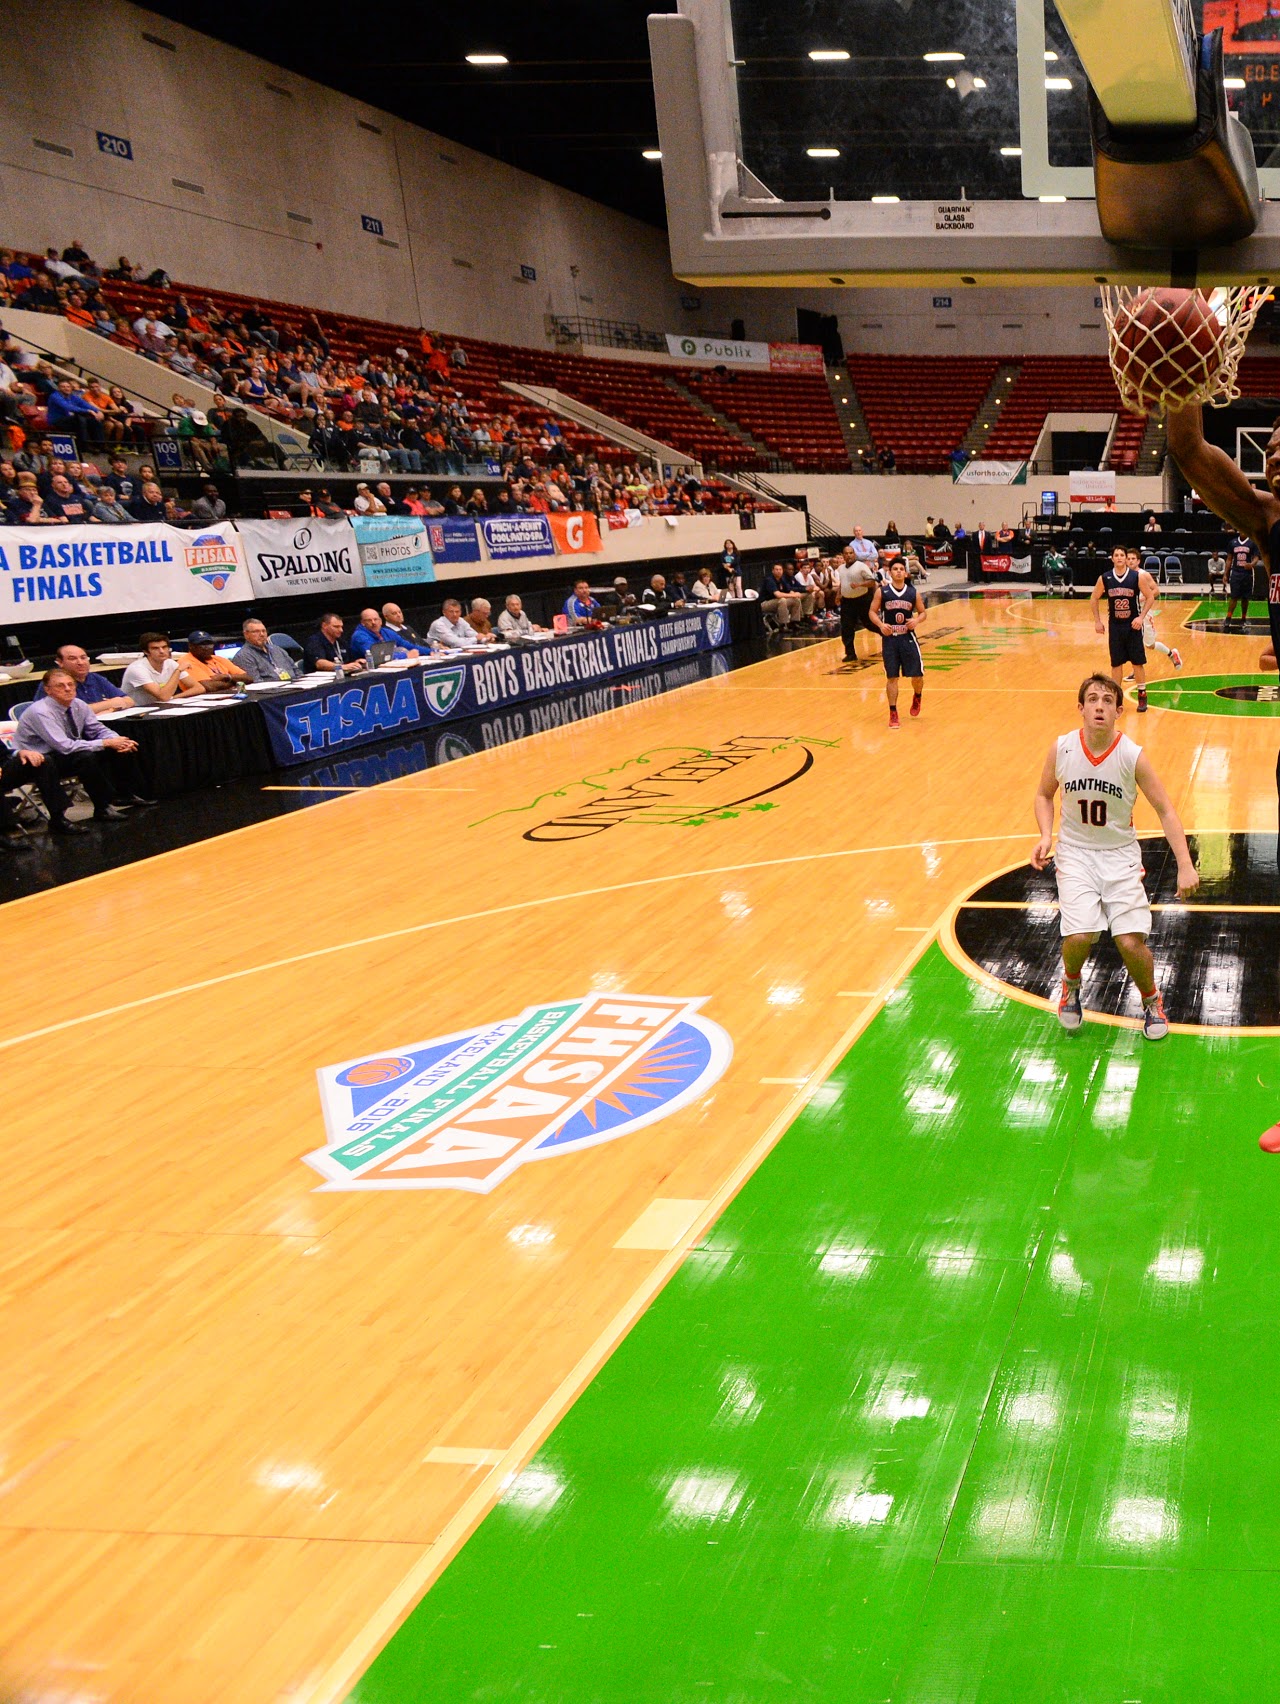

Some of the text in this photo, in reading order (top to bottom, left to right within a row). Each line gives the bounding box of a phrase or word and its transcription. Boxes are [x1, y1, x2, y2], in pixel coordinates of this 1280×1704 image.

[102, 135, 128, 156] 210
[938, 206, 971, 214] GUARDIAN
[944, 214, 965, 222] GLASS
[366, 219, 380, 233] 211
[936, 222, 975, 230] BACKBOARD
[704, 344, 752, 358] Publix
[53, 443, 73, 455] 108
[154, 441, 177, 455] 109
[966, 468, 1013, 479] usfortho.com
[566, 515, 584, 550] G
[19, 540, 173, 570] BASKETBALL
[186, 546, 238, 565] FHSAA
[380, 545, 411, 557] PHOTOS
[257, 547, 353, 583] SPALDING
[12, 572, 103, 602] FINALS
[286, 578, 301, 587] TRUE
[1114, 598, 1130, 610] 22
[674, 619, 686, 636] HIGH
[895, 612, 905, 624] 0
[472, 625, 659, 706] BOYS BASKETBALL FINALS
[284, 678, 420, 755] FHSAA
[522, 735, 794, 842] LAKELAND
[1065, 778, 1123, 799] PANTHERS
[1077, 799, 1107, 827] 10
[341, 1010, 567, 1157] BASKETBALL FINALS
[347, 1024, 519, 1132] LAKELAND 2016
[379, 998, 676, 1172] FHSAA
